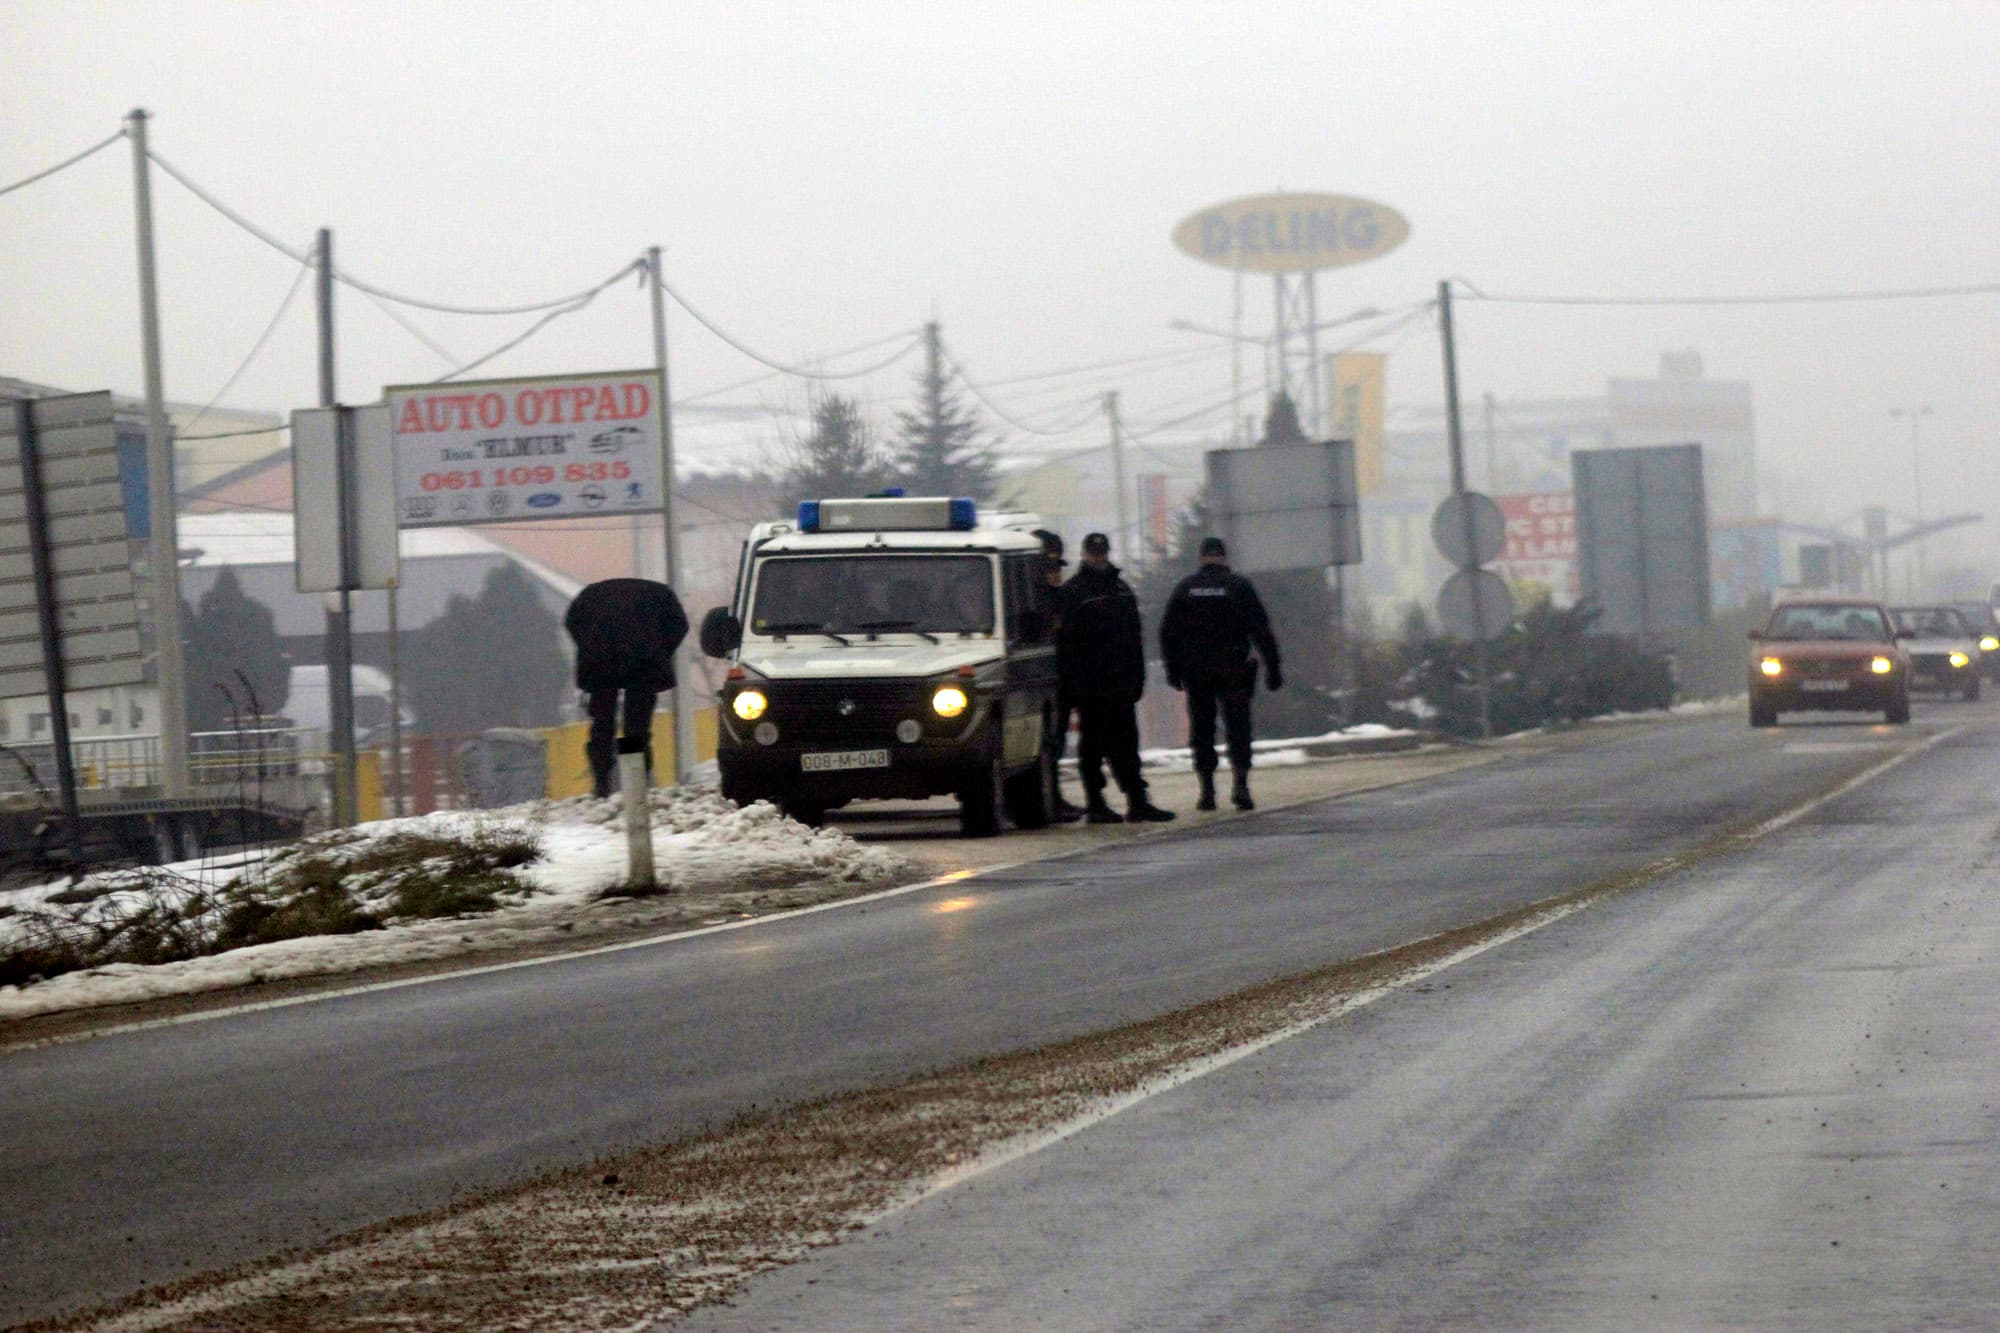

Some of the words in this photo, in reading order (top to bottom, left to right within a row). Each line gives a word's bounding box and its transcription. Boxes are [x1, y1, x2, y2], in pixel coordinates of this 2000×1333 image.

[1203, 206, 1379, 255] DELING
[398, 392, 505, 433] AUTO
[515, 383, 651, 427] OTPAD
[420, 470, 484, 491] 061
[494, 466, 555, 487] 109
[564, 461, 632, 482] 835
